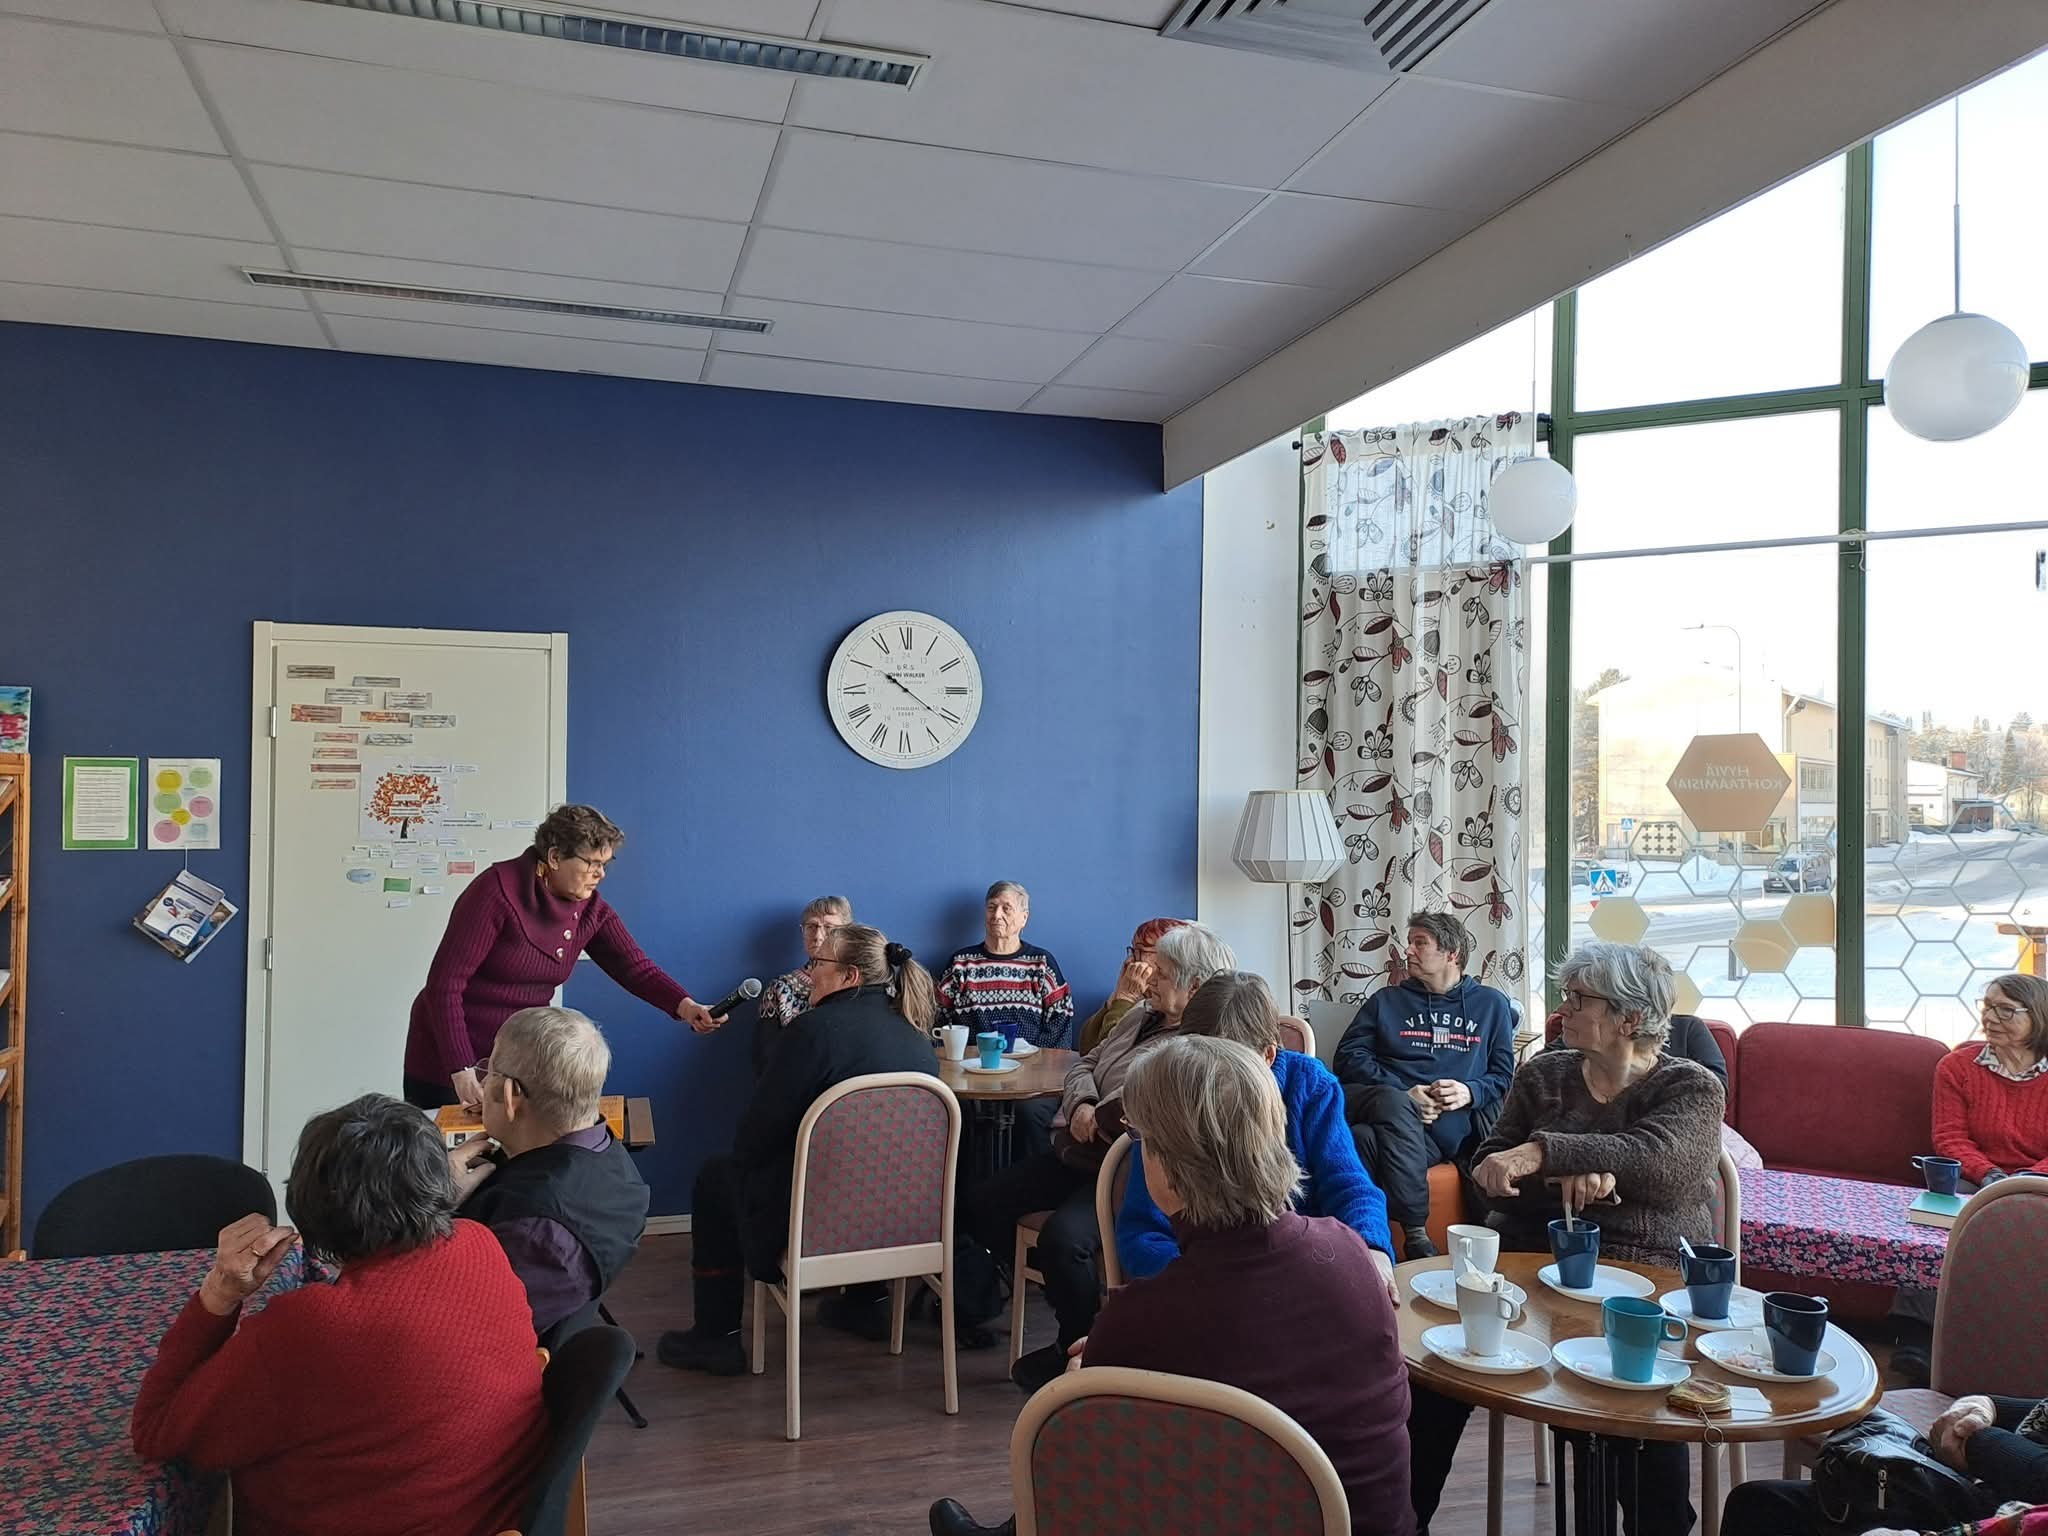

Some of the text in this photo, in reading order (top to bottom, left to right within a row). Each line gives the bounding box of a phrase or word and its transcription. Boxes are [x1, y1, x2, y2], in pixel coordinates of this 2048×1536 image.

[898, 626, 913, 651] XII
[1405, 1011, 1478, 1033] VINSON
[1411, 1040, 1442, 1049] AMERIAN
